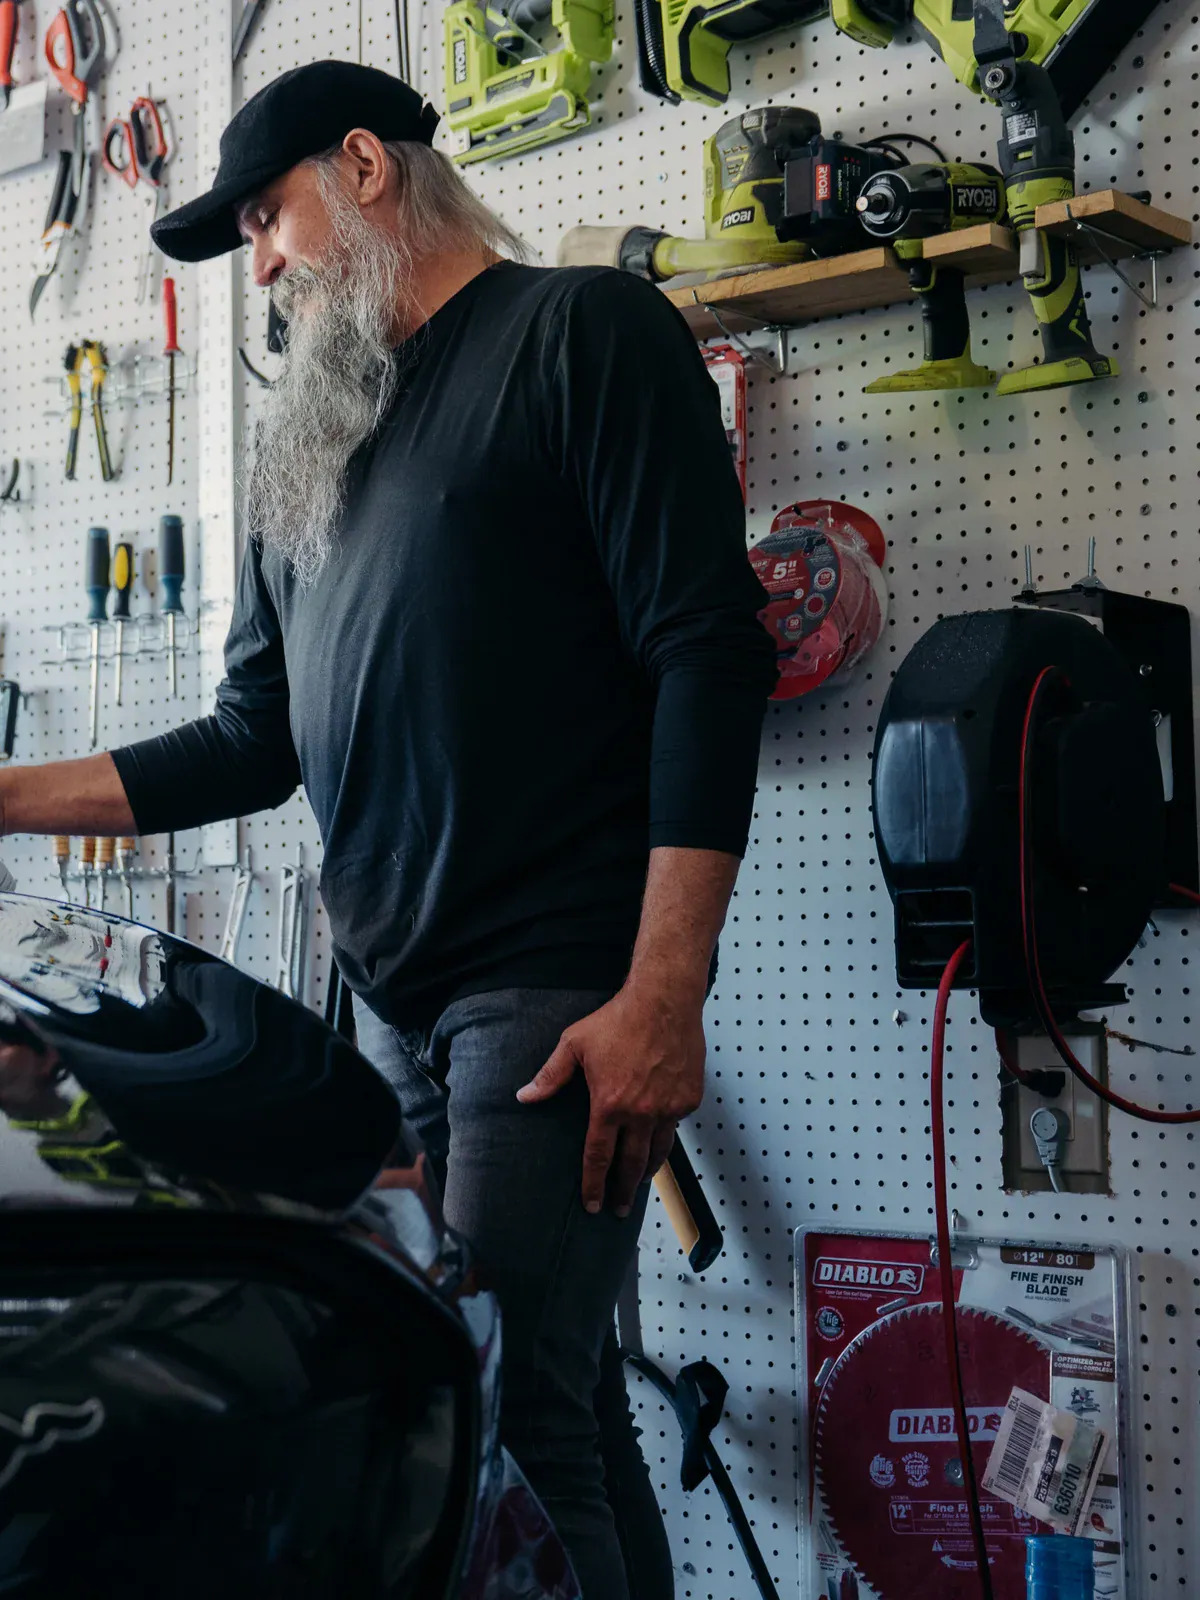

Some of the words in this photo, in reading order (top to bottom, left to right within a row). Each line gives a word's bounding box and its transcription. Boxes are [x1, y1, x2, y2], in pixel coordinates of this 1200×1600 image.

[455, 39, 467, 83] RYOBI
[818, 166, 828, 198] RYOBI
[957, 187, 996, 207] RYOBI
[723, 210, 751, 227] RYOBI
[772, 560, 797, 580] 5"
[1056, 1253, 1081, 1266] 80T
[819, 1263, 895, 1286] DIABLO
[1010, 1271, 1039, 1282] FINE
[1042, 1273, 1084, 1286] FINISH
[1026, 1284, 1068, 1296] BLADE
[1057, 1356, 1093, 1365] OPTIMIZED
[1054, 1463, 1081, 1516] 636010
[891, 1504, 912, 1519] 12"
[929, 1503, 954, 1513] Fine
[958, 1503, 993, 1513] Fish
